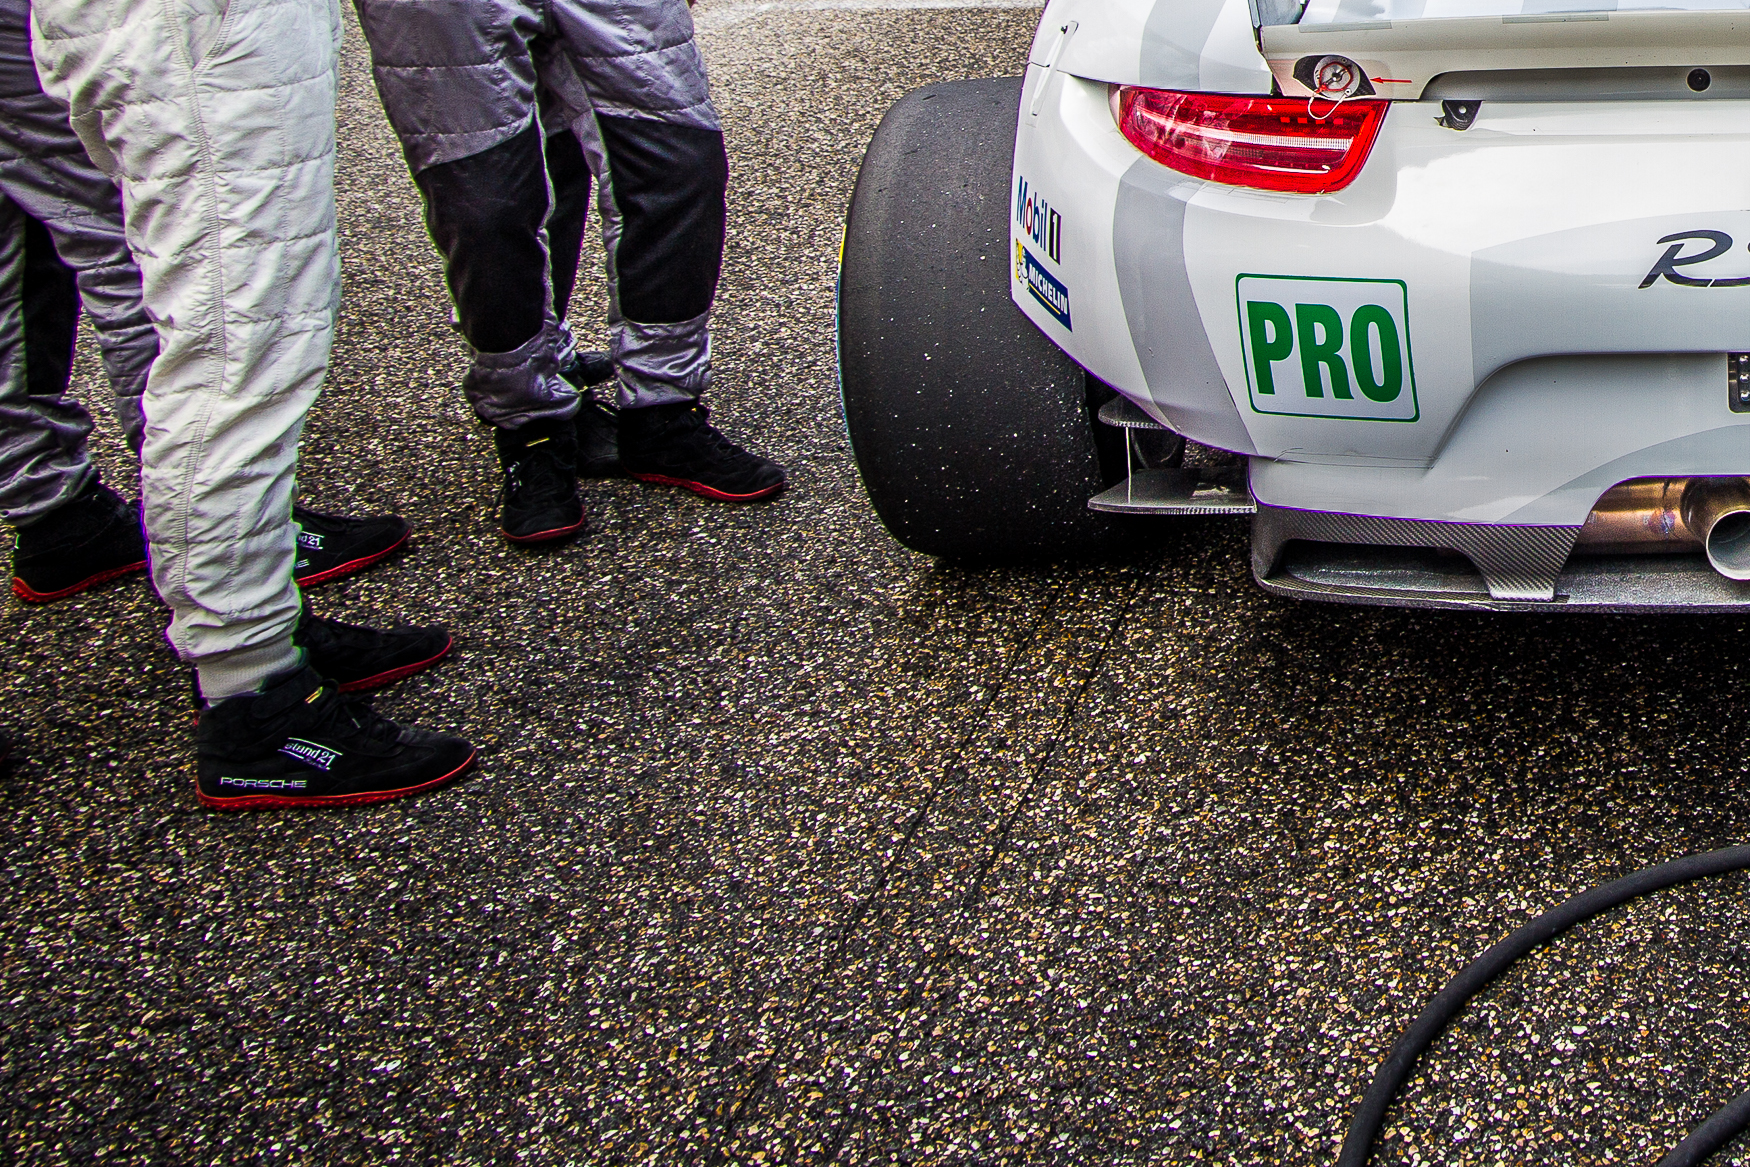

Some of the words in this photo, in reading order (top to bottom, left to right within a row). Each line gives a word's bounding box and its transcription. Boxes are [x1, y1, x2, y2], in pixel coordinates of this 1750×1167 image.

[1016, 176, 1048, 252] Mobil
[1028, 263, 1069, 315] MICHELIN
[1246, 300, 1405, 404] PRO
[220, 776, 307, 789] PORSCHE
